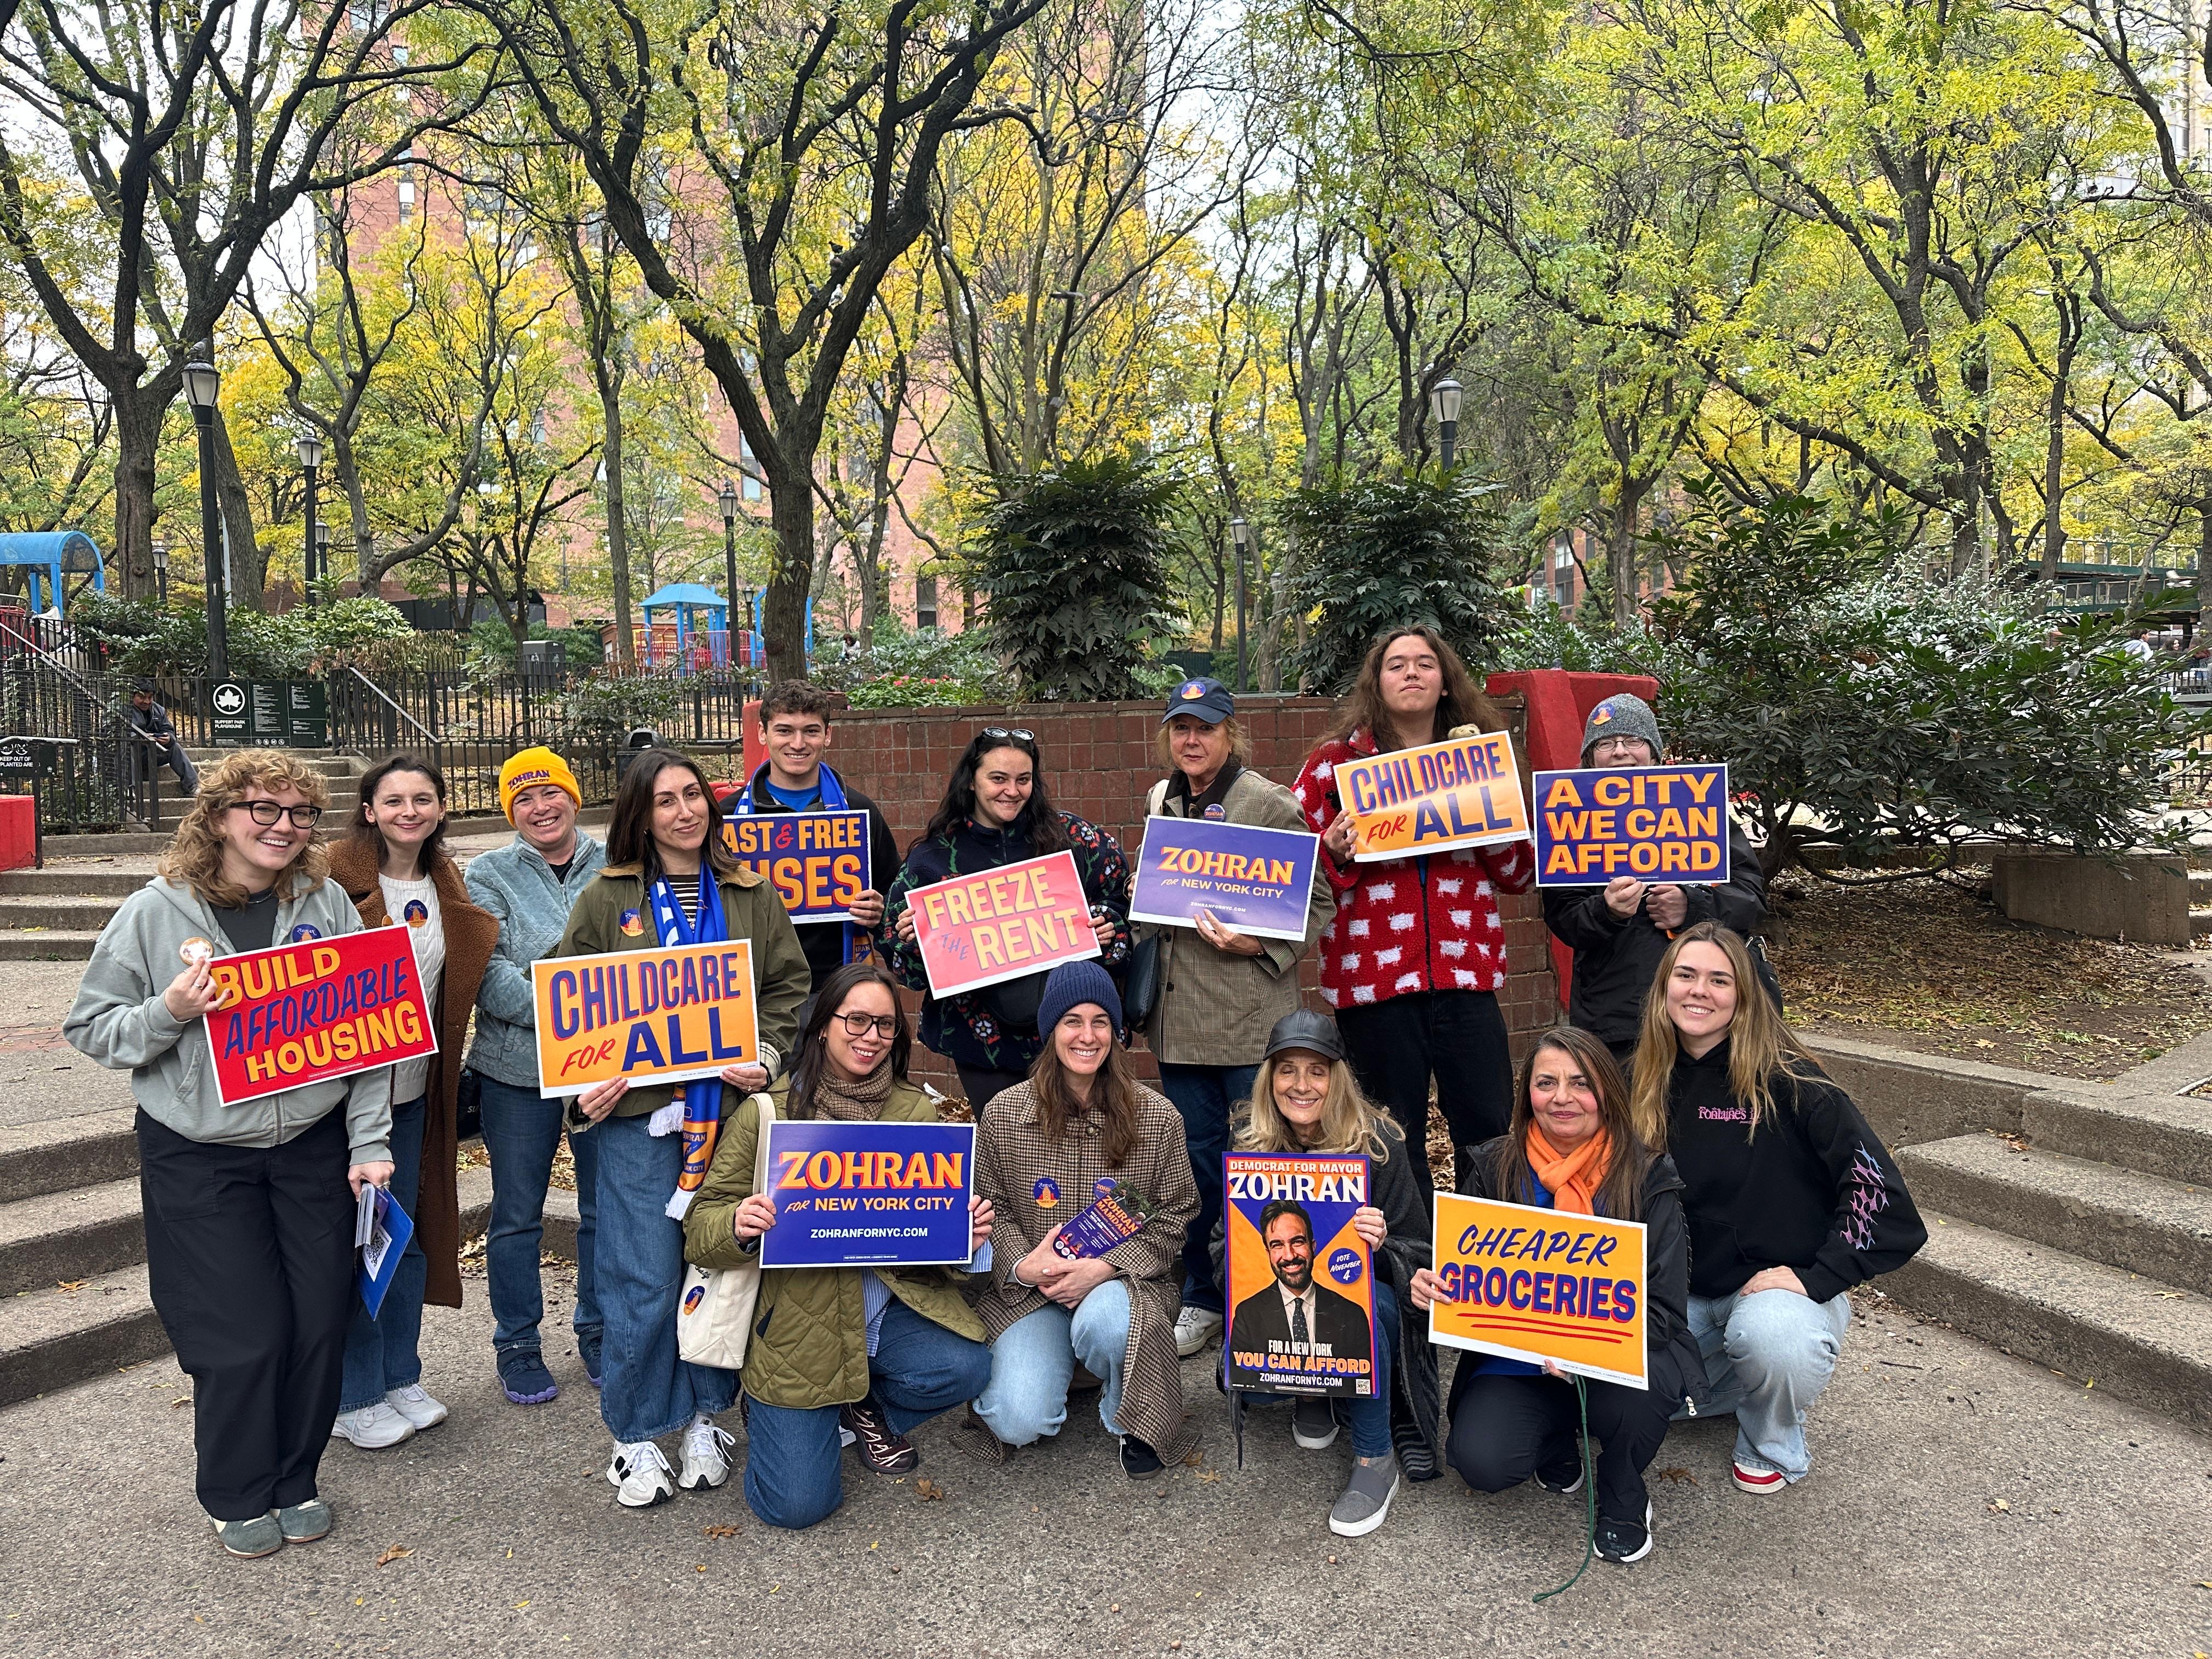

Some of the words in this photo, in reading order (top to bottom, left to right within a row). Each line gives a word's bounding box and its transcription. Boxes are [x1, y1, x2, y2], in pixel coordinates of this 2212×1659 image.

[507, 770, 550, 791] ZOHRAN
[1350, 742, 1506, 817] CHILDCARE
[1544, 778, 1583, 808] A
[1594, 772, 1718, 806] CITY
[1365, 814, 1407, 846] FOR
[1413, 786, 1513, 842] ALL
[1544, 809, 1616, 841] WE
[1625, 806, 1718, 839] CAN
[722, 821, 774, 853] AST
[775, 823, 793, 849] &
[798, 817, 861, 850] FREE
[1157, 847, 1295, 885] ZOHRAN
[1545, 840, 1721, 875] AFFORD
[922, 866, 1056, 931] FREEZE
[1160, 878, 1179, 887] FOR
[1181, 878, 1212, 890] NEW
[1215, 882, 1250, 895] YORK
[1253, 887, 1284, 899] CITY
[1190, 901, 1246, 912] ZOHRANFORNYC.COM
[941, 933, 969, 960] THE
[971, 908, 1079, 970] RENT
[211, 947, 341, 1012] BUILD
[550, 952, 741, 1041] CHILDCARE
[224, 957, 408, 1059] AFFORDABLE
[245, 1001, 423, 1085] HOUSING
[561, 1039, 616, 1076] FOR
[622, 1007, 742, 1071] ALL
[776, 1150, 964, 1190] ZOHRAN
[1230, 1161, 1291, 1173] DEMOCRAT
[1294, 1163, 1317, 1173] FOR
[1319, 1163, 1362, 1174] MAYOR
[785, 1200, 810, 1214] FOR
[815, 1198, 862, 1211] NEW
[862, 1197, 910, 1210] YORK
[915, 1197, 954, 1210] CITY
[1097, 1183, 1111, 1192] ZOHR
[1227, 1172, 1366, 1203] ZOHRAN
[1096, 1200, 1131, 1237] MAMDANI
[1102, 1194, 1139, 1233] ZOHRAN
[811, 1227, 928, 1238] ZOHRANFORNYC.COM
[1457, 1224, 1618, 1267] CHEAPER
[1330, 1260, 1361, 1272] NOVEMBER
[1336, 1254, 1351, 1262] VOTE
[1343, 1269, 1350, 1280] 4
[1438, 1262, 1637, 1324] GROCERIES
[1233, 1351, 1265, 1369] YOU
[1267, 1353, 1301, 1371] CAN
[1304, 1357, 1370, 1375] AFFORD
[1268, 1339, 1283, 1353] FOR
[1284, 1341, 1291, 1354] A
[1292, 1342, 1309, 1355] NEW
[1311, 1342, 1333, 1357] YORK
[1260, 1373, 1342, 1387] ZOHRANFORNYC.COM
